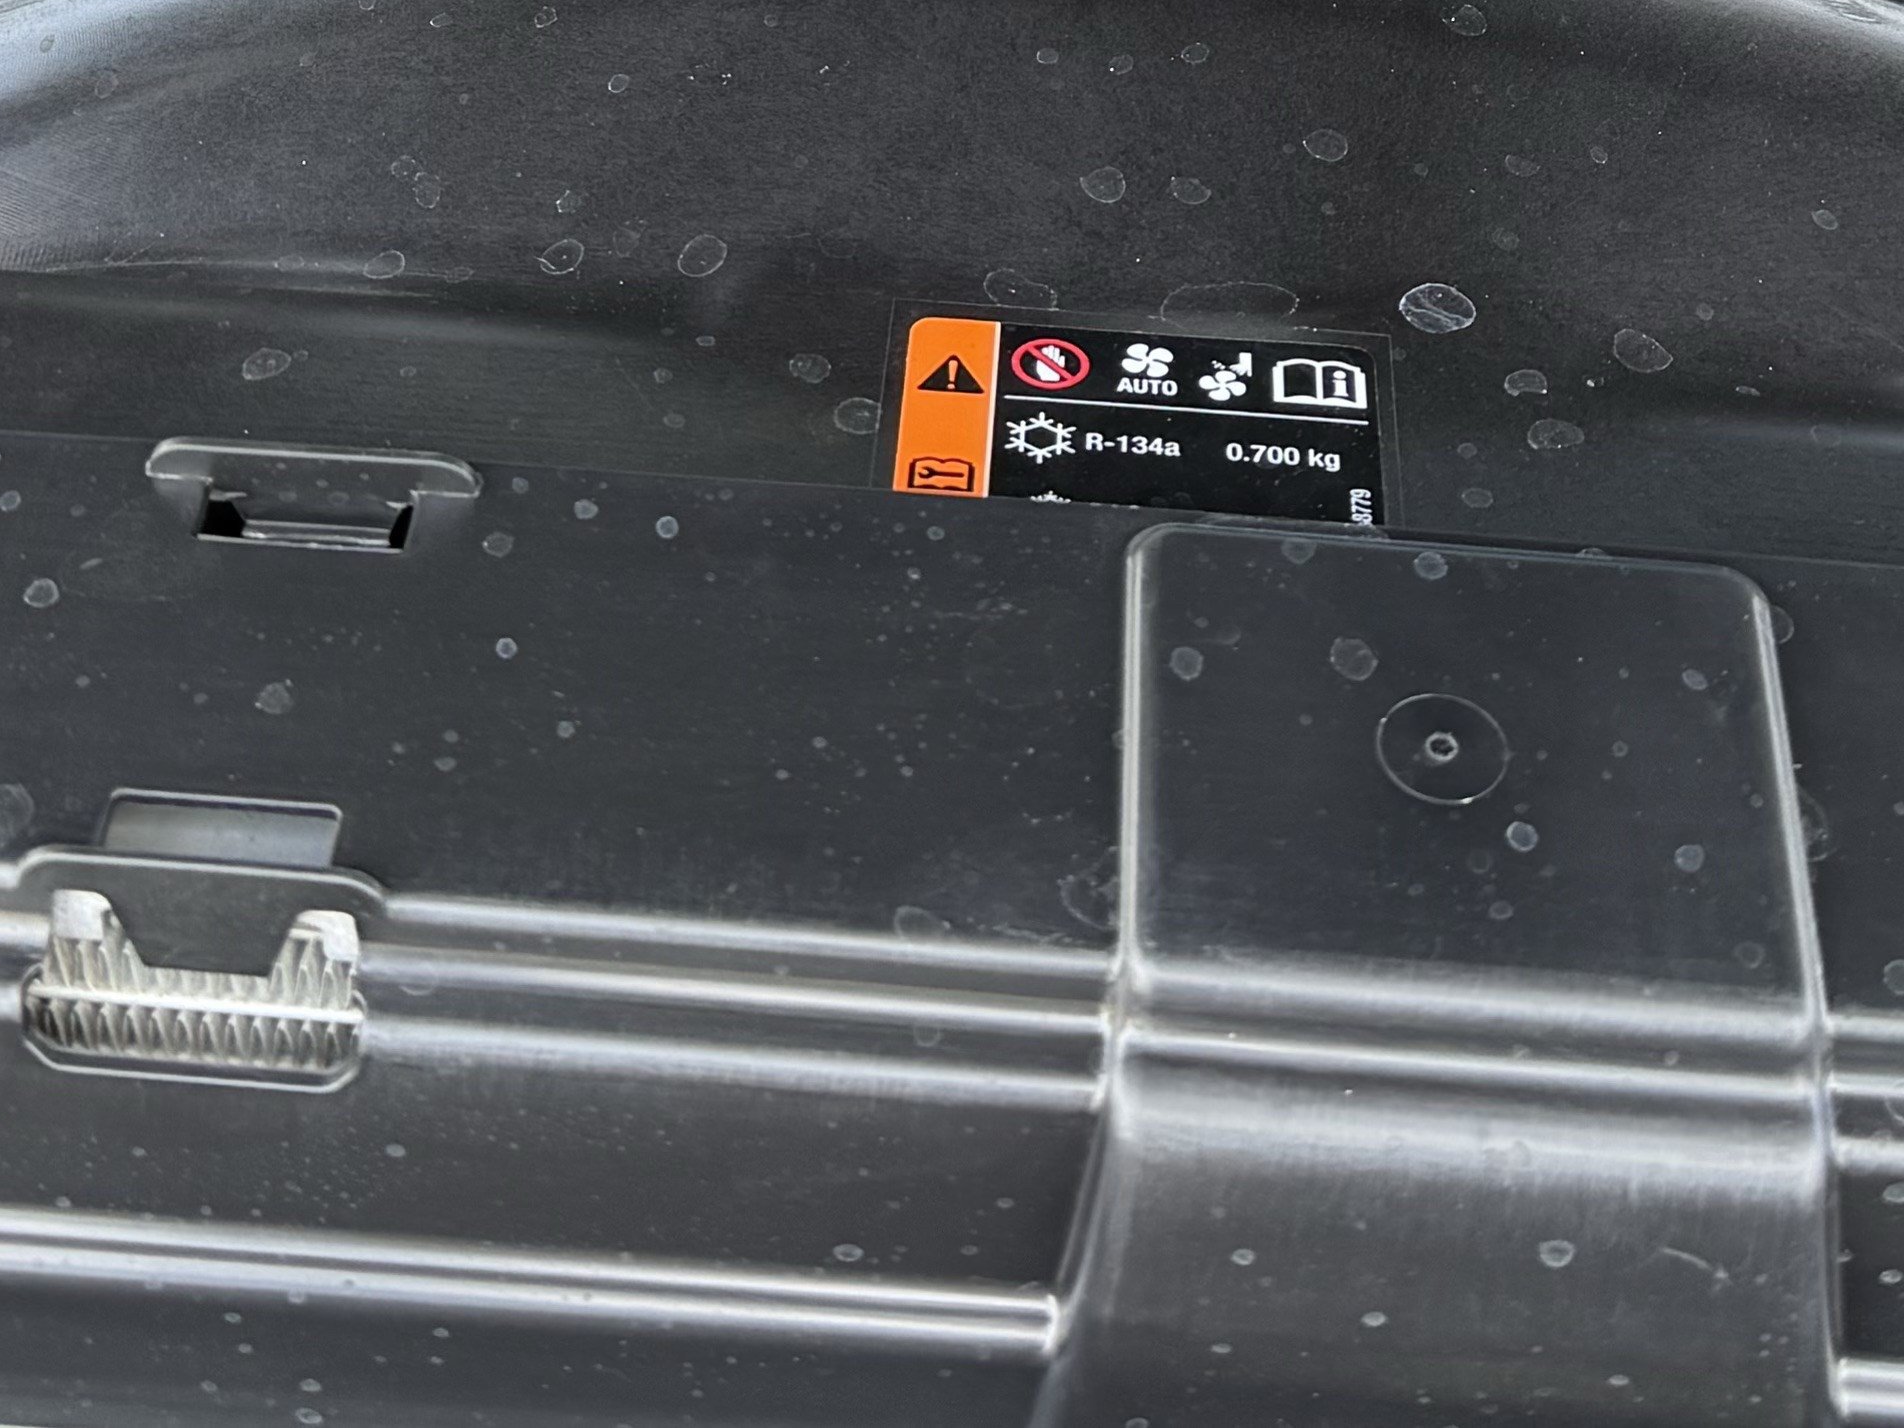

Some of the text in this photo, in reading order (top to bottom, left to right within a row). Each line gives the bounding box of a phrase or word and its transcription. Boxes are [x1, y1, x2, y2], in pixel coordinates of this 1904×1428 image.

[1117, 377, 1178, 396] AUTO
[1085, 432, 1341, 473] R-134a 0.700 kg
